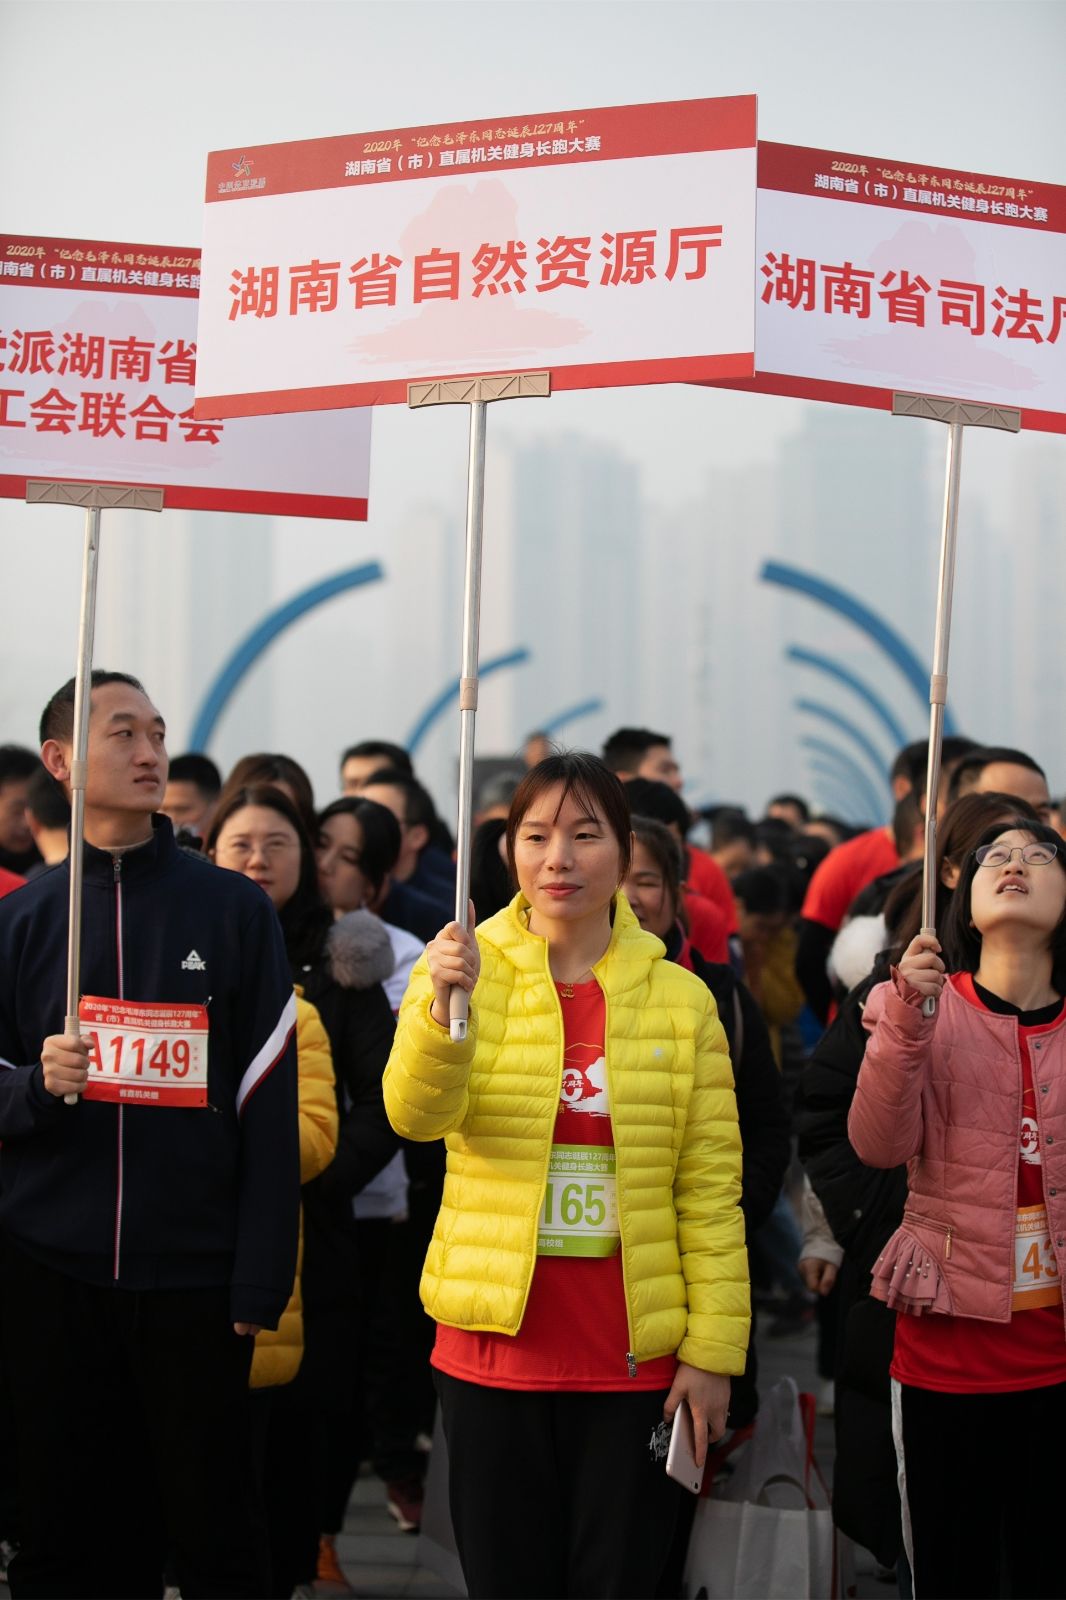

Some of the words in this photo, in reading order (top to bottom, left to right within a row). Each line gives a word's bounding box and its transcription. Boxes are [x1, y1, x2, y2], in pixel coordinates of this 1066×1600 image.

[344, 136, 601, 177] 湖南省（市）直属机关健身长跑大赛
[814, 173, 1049, 223] 湖南省（市）直属机关健身长跑大赛
[0, 260, 200, 289] 南省（市）直属机关健身长跑
[228, 224, 724, 321] 湖南省自然资源厅
[0, 329, 197, 387] 派湖南省
[0, 387, 224, 445] 工会联合会
